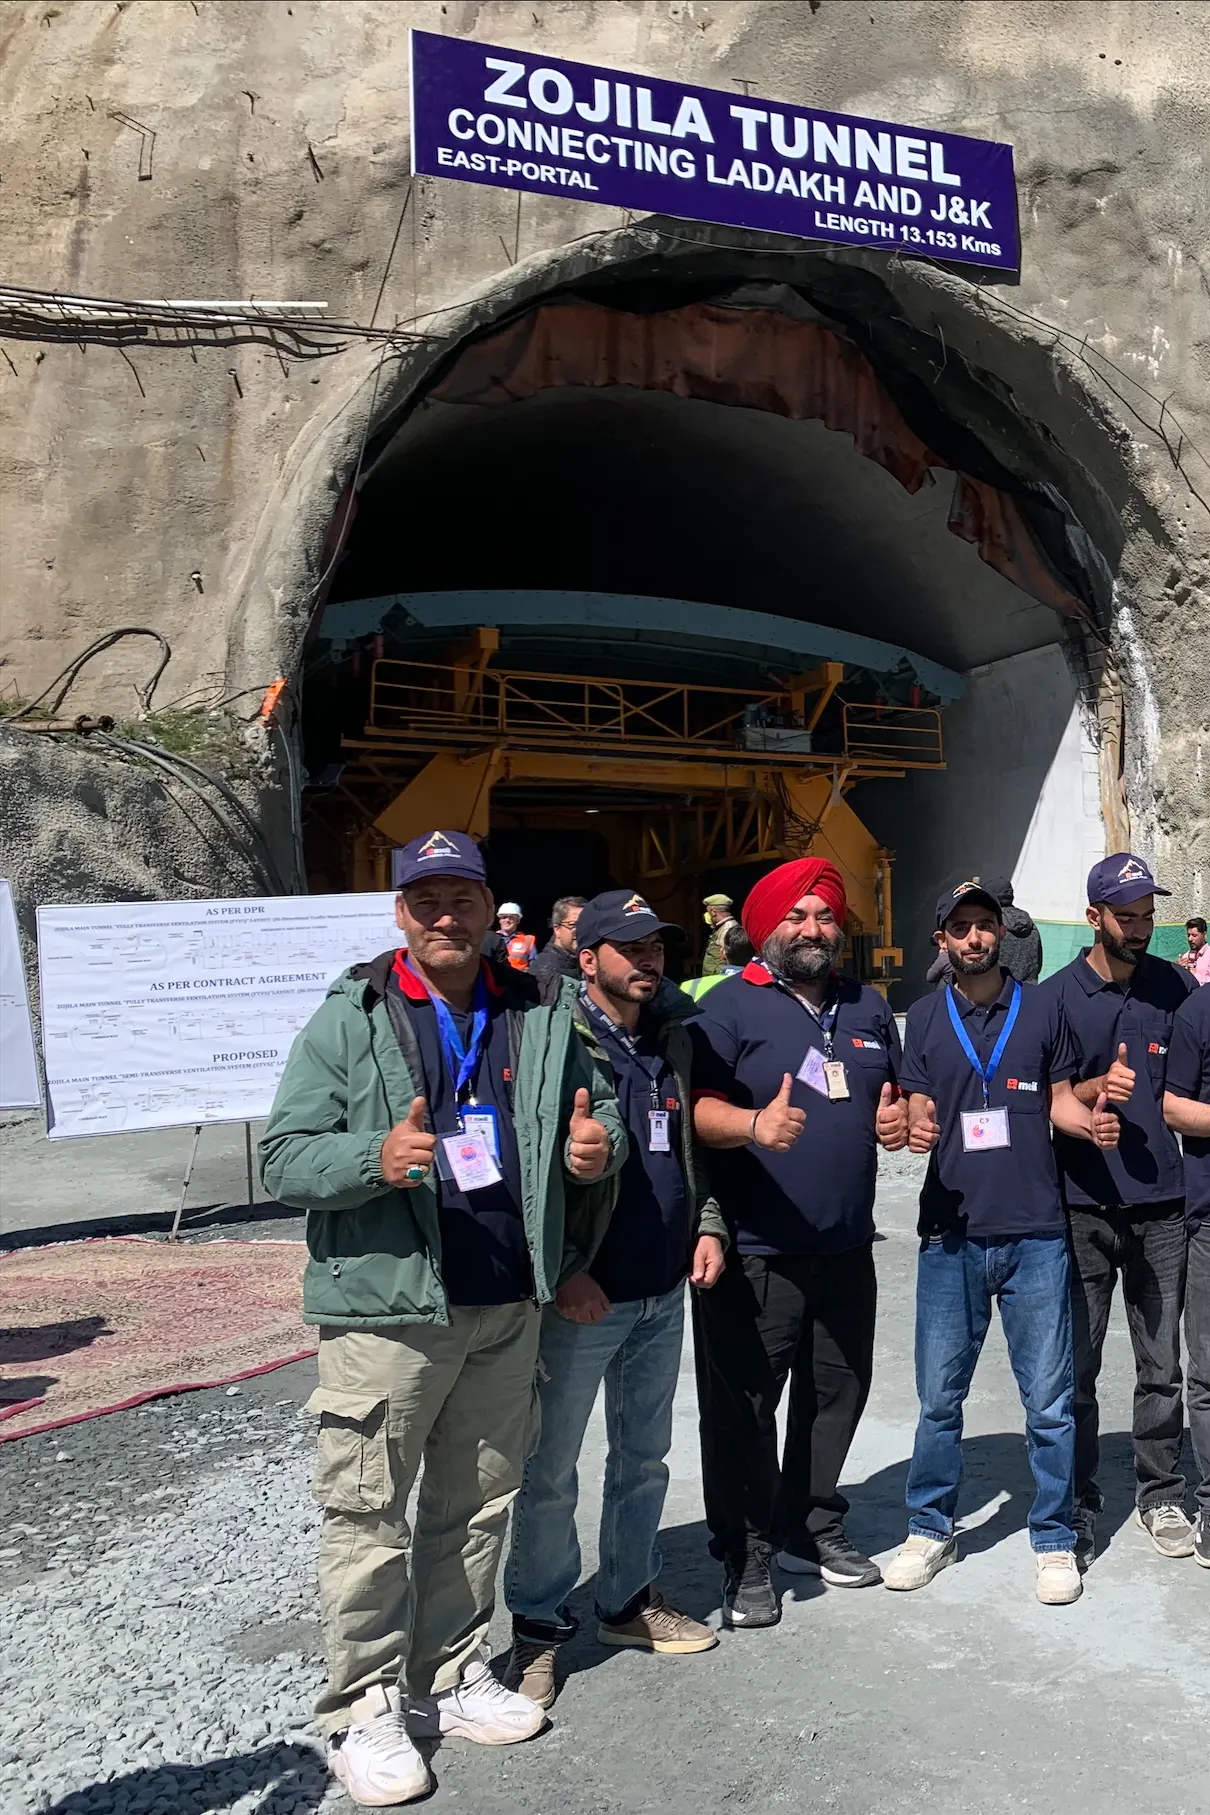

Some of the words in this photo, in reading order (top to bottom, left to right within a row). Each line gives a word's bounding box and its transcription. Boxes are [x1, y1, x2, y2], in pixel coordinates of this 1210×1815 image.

[484, 57, 714, 143] ZOJILA
[729, 104, 961, 187] TUNNEL
[437, 147, 600, 191] EAST-PORTAL
[448, 108, 696, 179] CONNECTING
[706, 153, 846, 205] LADAKH
[853, 180, 922, 217] AND
[930, 193, 993, 230] J&K
[814, 211, 895, 239] LENGTH
[899, 224, 958, 249] 13.153
[961, 234, 1002, 256] Kms
[206, 908, 219, 916] AS
[221, 907, 242, 915] PER
[243, 906, 266, 914] DPR
[150, 983, 165, 991] AS
[168, 981, 190, 990] PER
[193, 976, 256, 988] CONTRACT
[258, 972, 327, 984] AGREEMENT
[213, 1049, 278, 1062] PROPOSED
[183, 1065, 226, 1073] VENTILATION
[1018, 1081, 1038, 1092] meil
